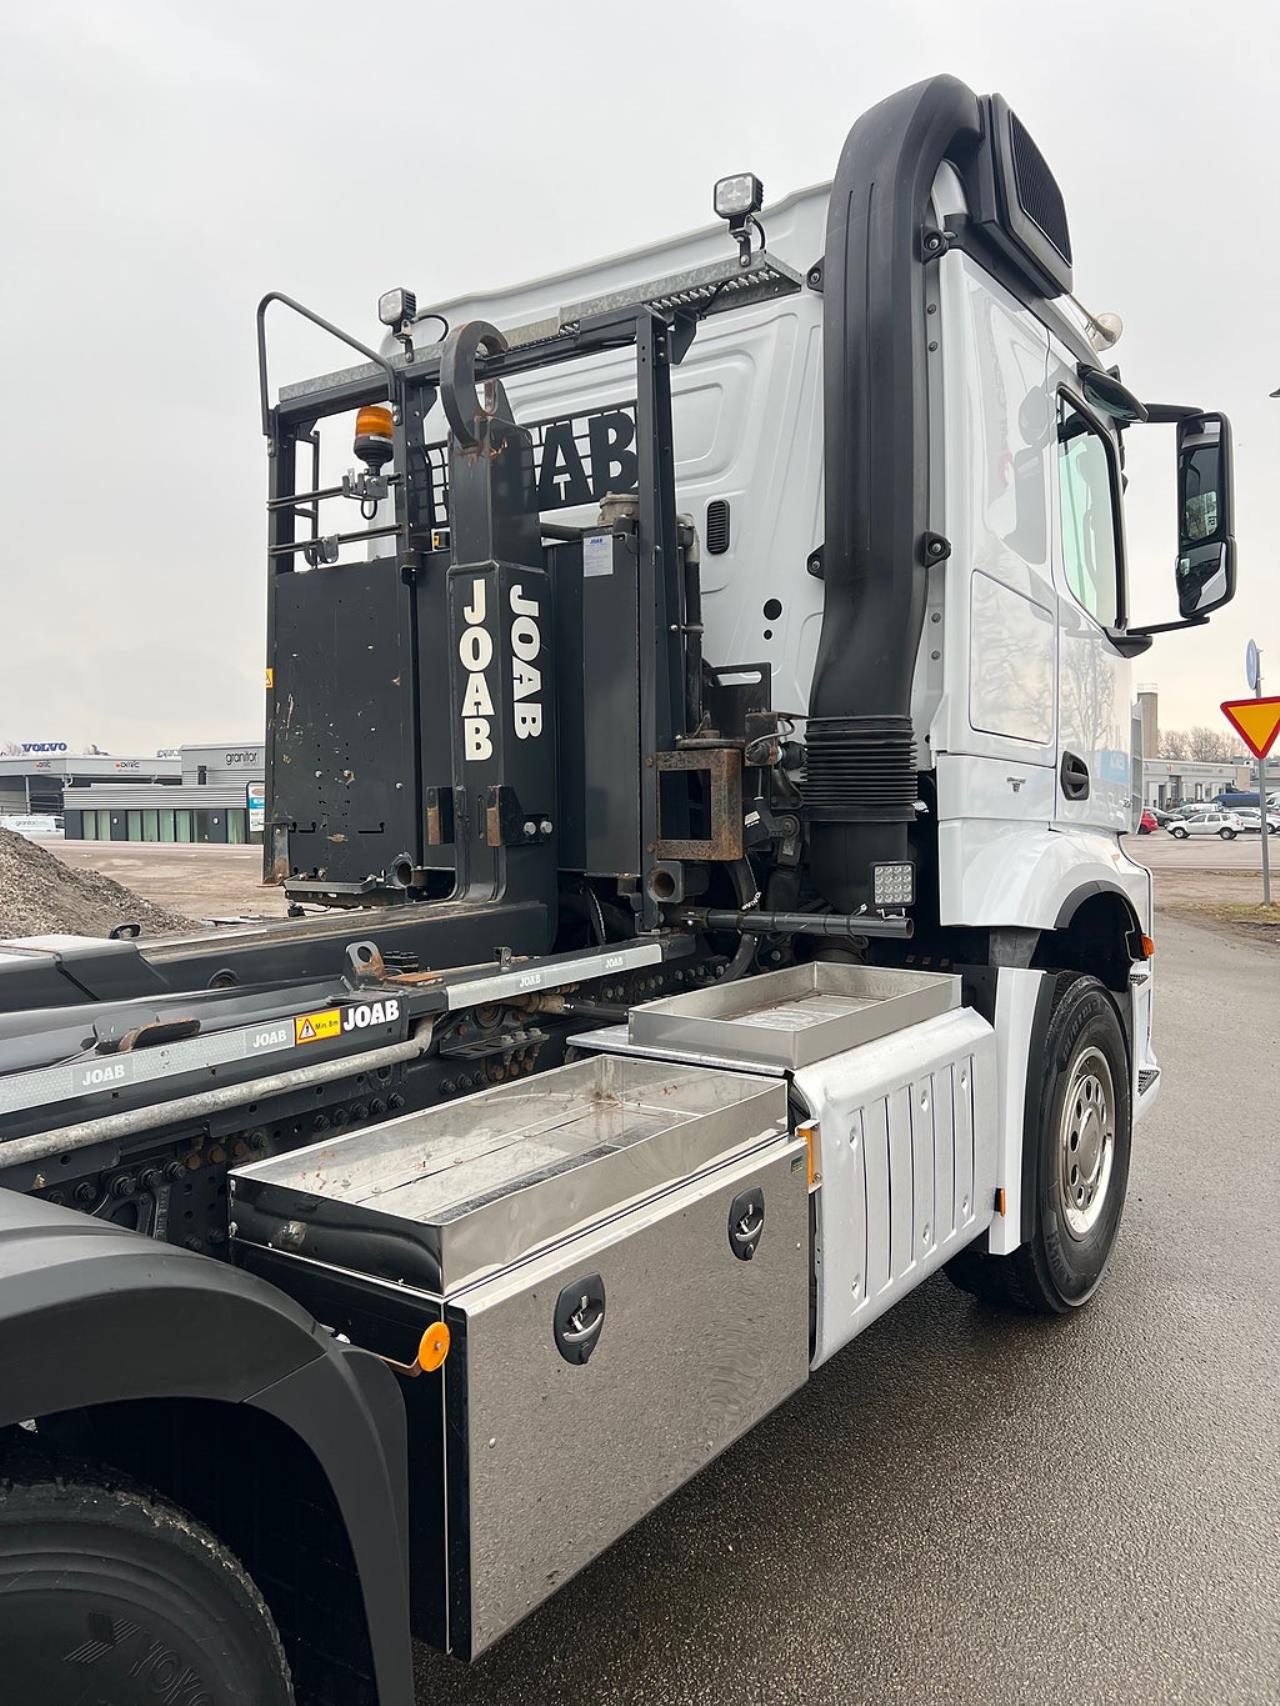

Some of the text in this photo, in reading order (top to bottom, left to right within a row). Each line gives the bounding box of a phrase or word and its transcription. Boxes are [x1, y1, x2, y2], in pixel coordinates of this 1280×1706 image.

[459, 579, 495, 761] JOAB
[510, 584, 543, 740] JOAB
[22, 742, 68, 752] VOLVO
[605, 957, 623, 968] JOAB
[520, 974, 541, 987] JOAB
[343, 1000, 399, 1030] JOAB
[253, 1030, 287, 1047] JOAB
[82, 1064, 125, 1085] JOAB
